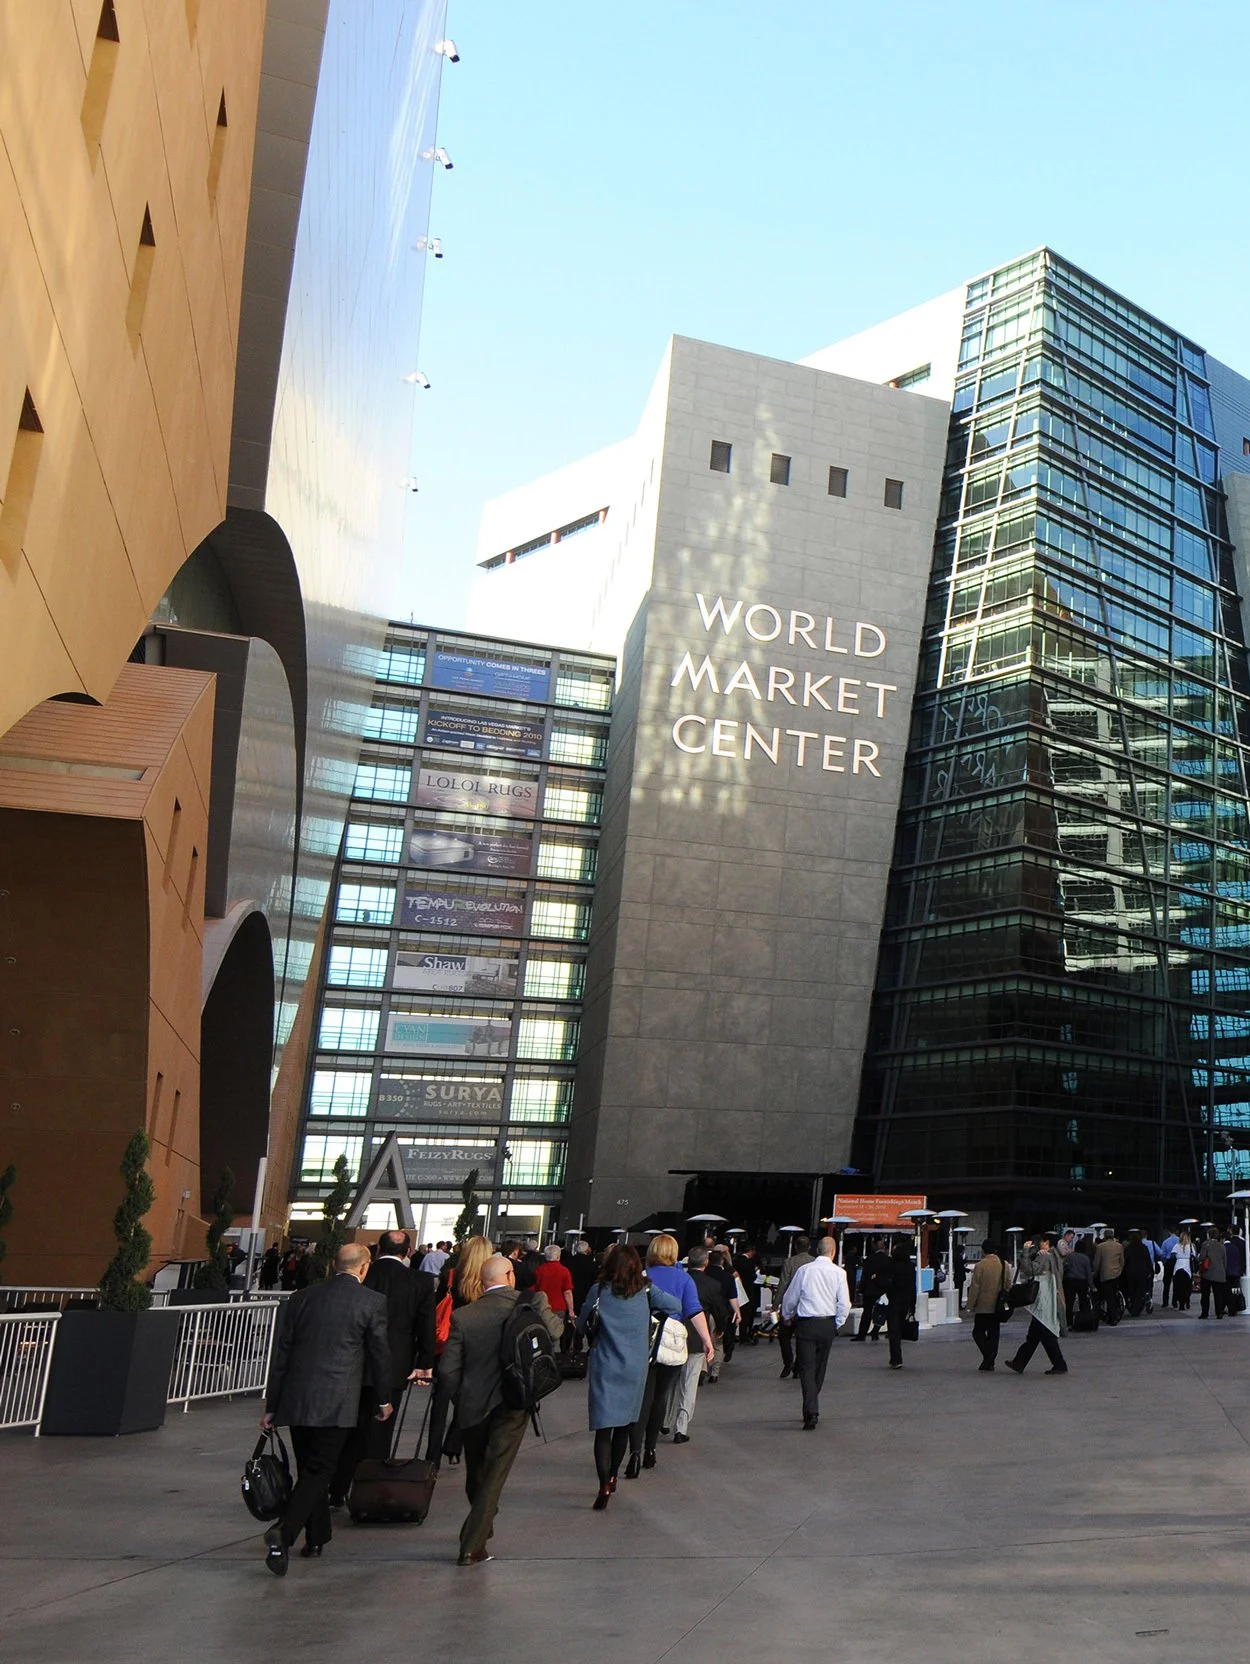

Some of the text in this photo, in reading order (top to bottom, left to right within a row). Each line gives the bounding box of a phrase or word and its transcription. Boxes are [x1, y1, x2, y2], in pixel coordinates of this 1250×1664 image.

[695, 592, 887, 658] WORLD
[438, 654, 485, 667] OPPORTUNITY
[486, 661, 511, 671] COMES
[520, 666, 546, 676] THREES
[670, 650, 898, 719] MARKET
[427, 719, 467, 730] KICKOFF
[467, 724, 480, 732] TO
[481, 726, 521, 737] BEDDING
[523, 732, 542, 740] 2010
[440, 715, 477, 725] INTRODUCING
[672, 714, 882, 778] CENTER
[426, 775, 532, 798] LOLOI RUGS
[414, 914, 458, 926] C-1512
[423, 956, 465, 971] Shaw
[395, 1023, 426, 1034] CYAN
[425, 1084, 502, 1101] SURYA
[467, 1102, 501, 1110] TEXTILES
[345, 1130, 416, 1229] A
